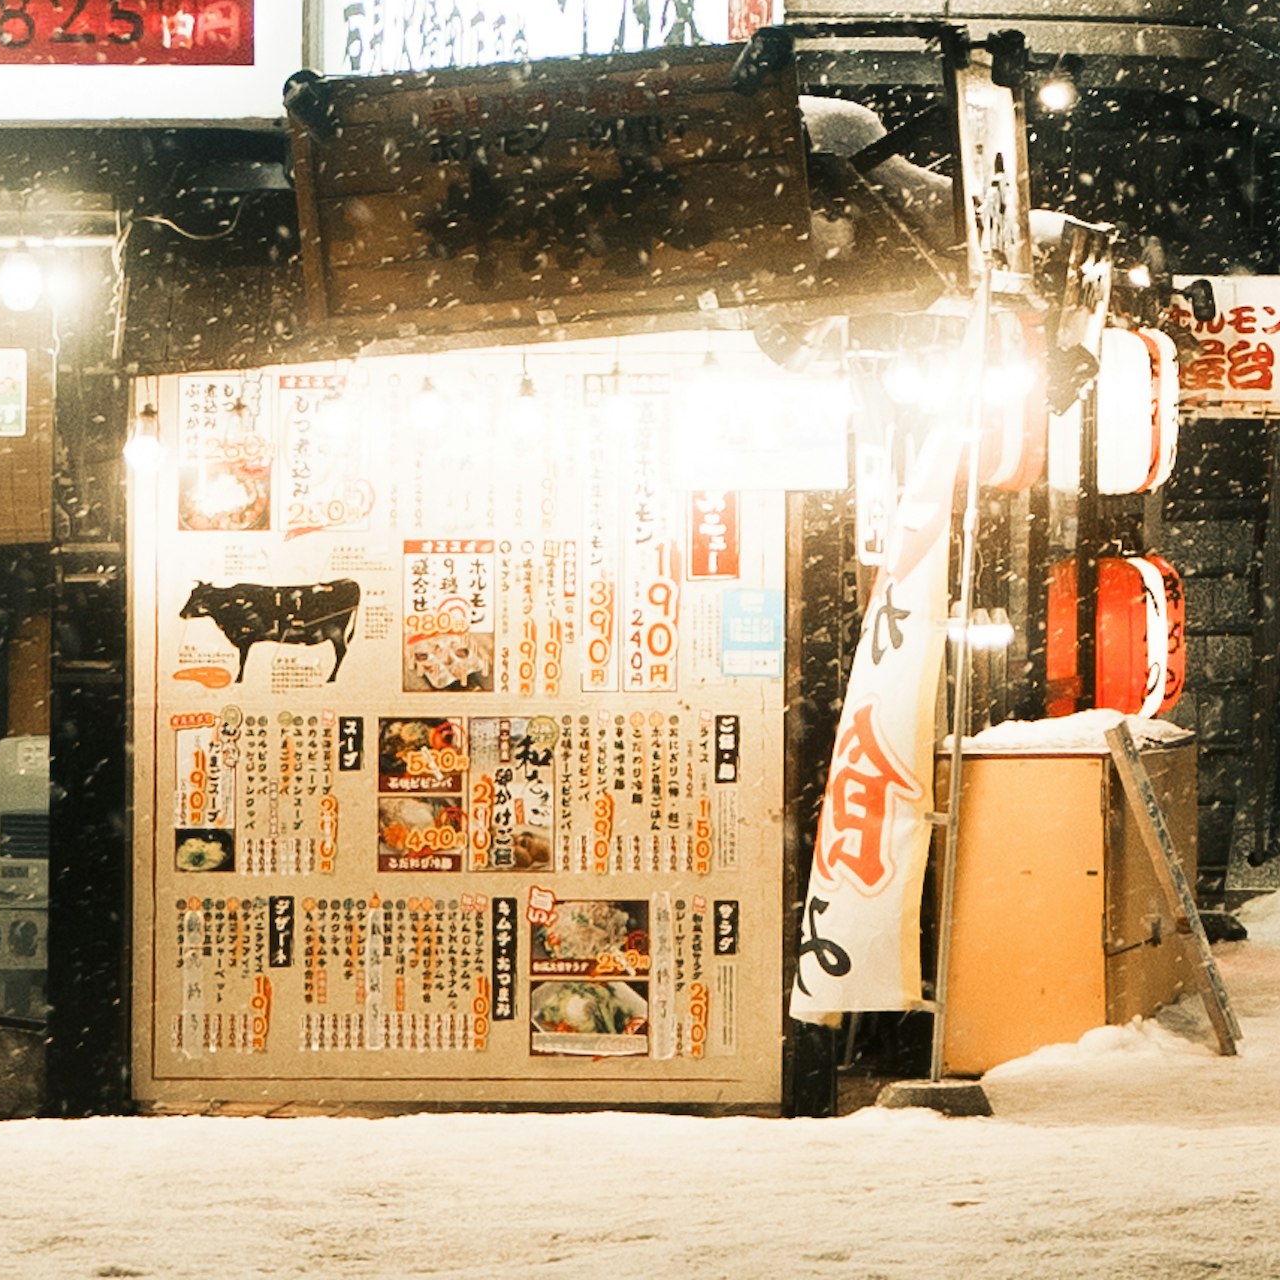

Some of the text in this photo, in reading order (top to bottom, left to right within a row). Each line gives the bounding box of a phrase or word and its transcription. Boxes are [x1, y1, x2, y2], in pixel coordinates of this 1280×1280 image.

[469, 558, 487, 625] ホルモン
[647, 541, 674, 684] 190円
[519, 621, 536, 693] 190円
[543, 621, 562, 693] 190円
[588, 580, 613, 685] 390円
[342, 719, 359, 768] スープ
[695, 799, 711, 873] 150円
[274, 896, 292, 965] デザート
[717, 903, 735, 952] サラダ
[690, 983, 709, 1057] 290円
